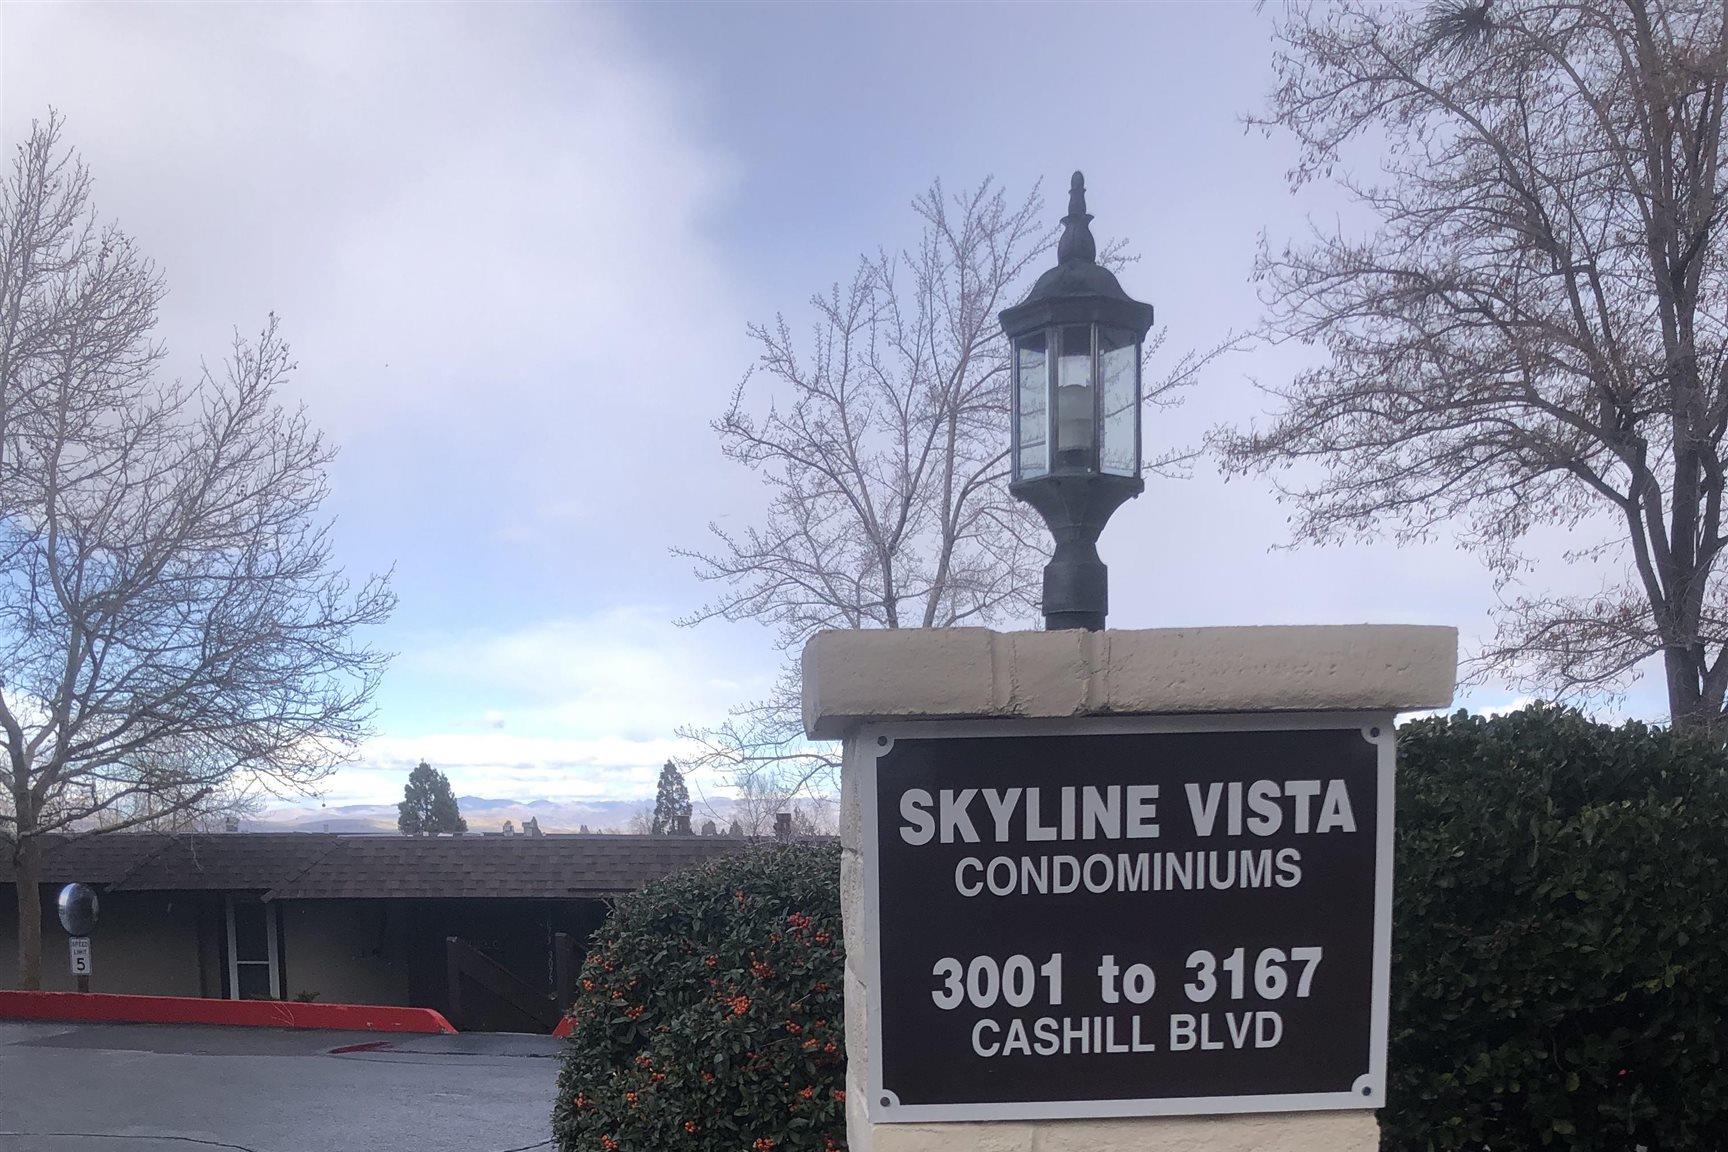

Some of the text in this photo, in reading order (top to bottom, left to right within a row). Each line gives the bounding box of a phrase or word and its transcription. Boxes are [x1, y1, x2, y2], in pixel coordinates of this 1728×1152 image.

[900, 780, 1356, 845] SKYLINE VISTA
[955, 848, 1301, 896] CONDOMINIUMS
[77, 958, 86, 971] 5
[932, 947, 1322, 1009] 3001 to 3167
[972, 1012, 1282, 1057] CASHILL BLVD
